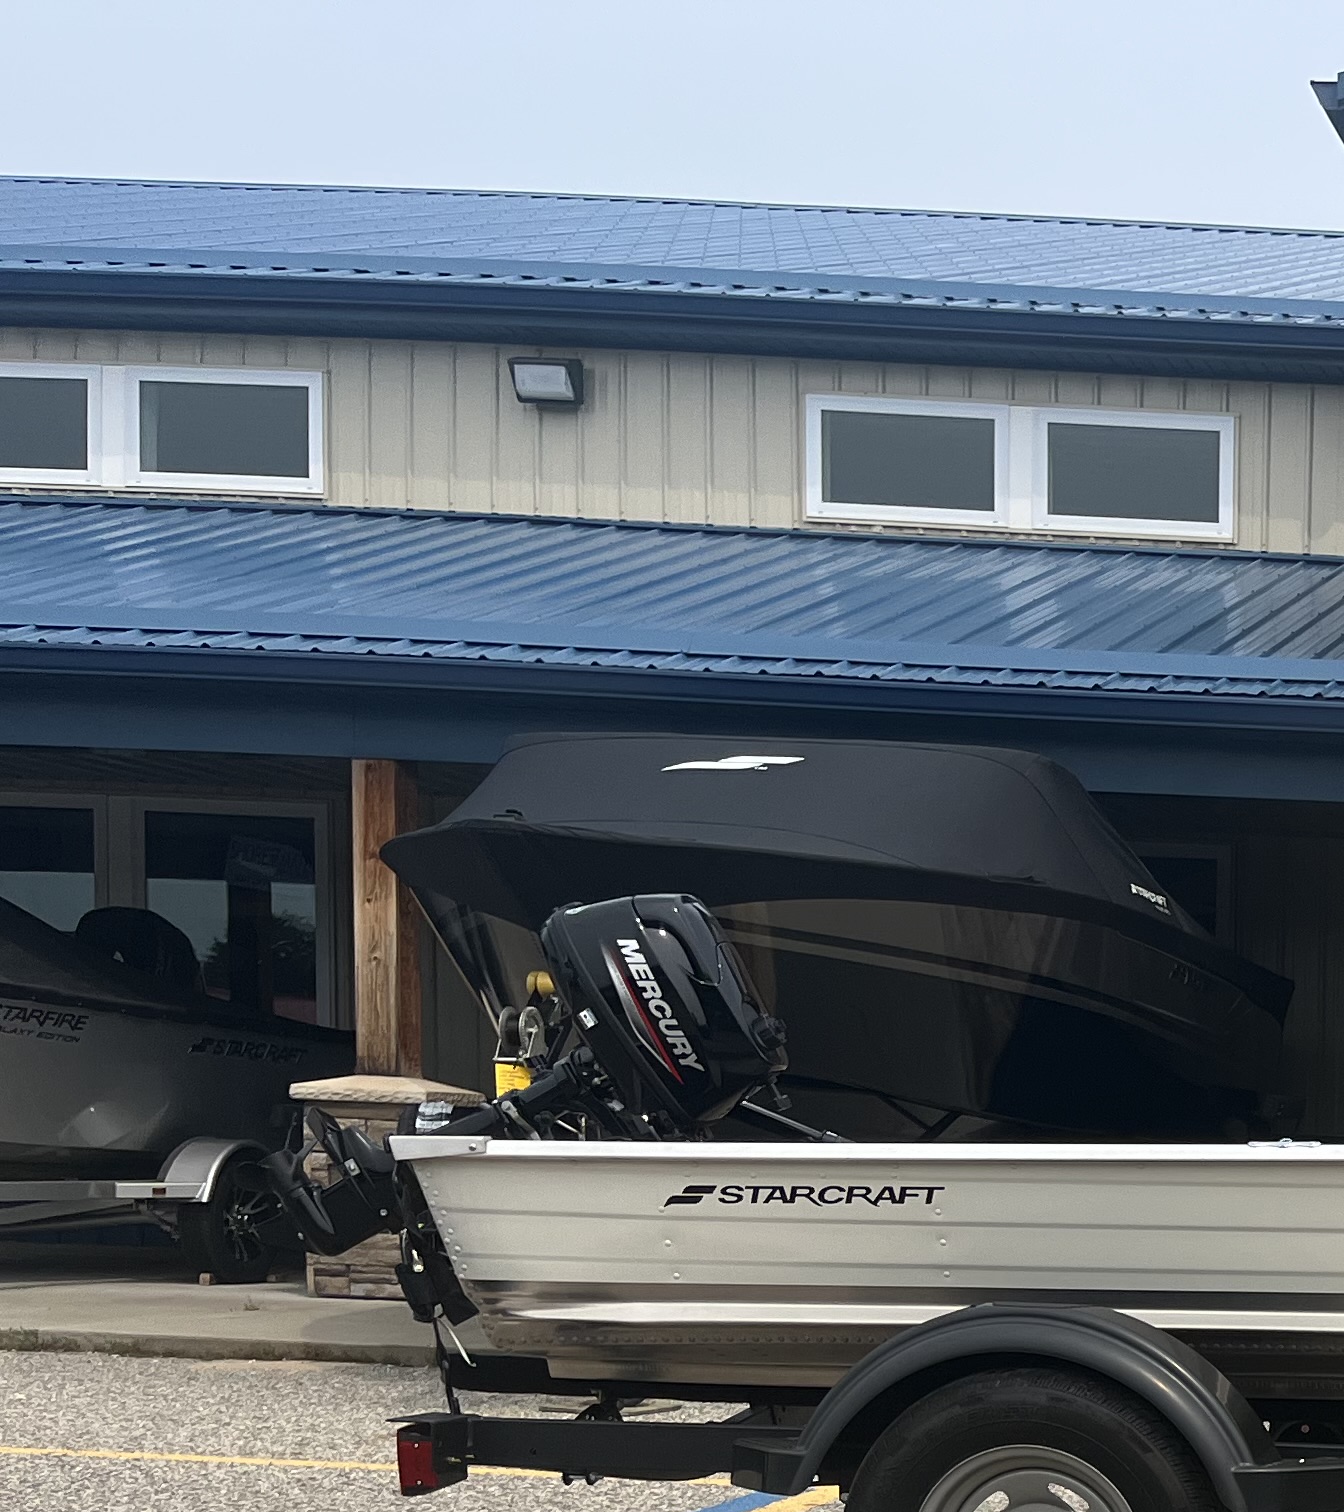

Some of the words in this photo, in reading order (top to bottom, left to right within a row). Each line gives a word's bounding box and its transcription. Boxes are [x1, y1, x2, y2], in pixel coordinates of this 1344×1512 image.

[616, 938, 706, 1072] MERCURY
[0, 1005, 89, 1031] TARFIRE
[36, 1032, 81, 1042] EDITION
[212, 1038, 308, 1063] STARCRAFT
[718, 1185, 945, 1207] STARCRAFT
